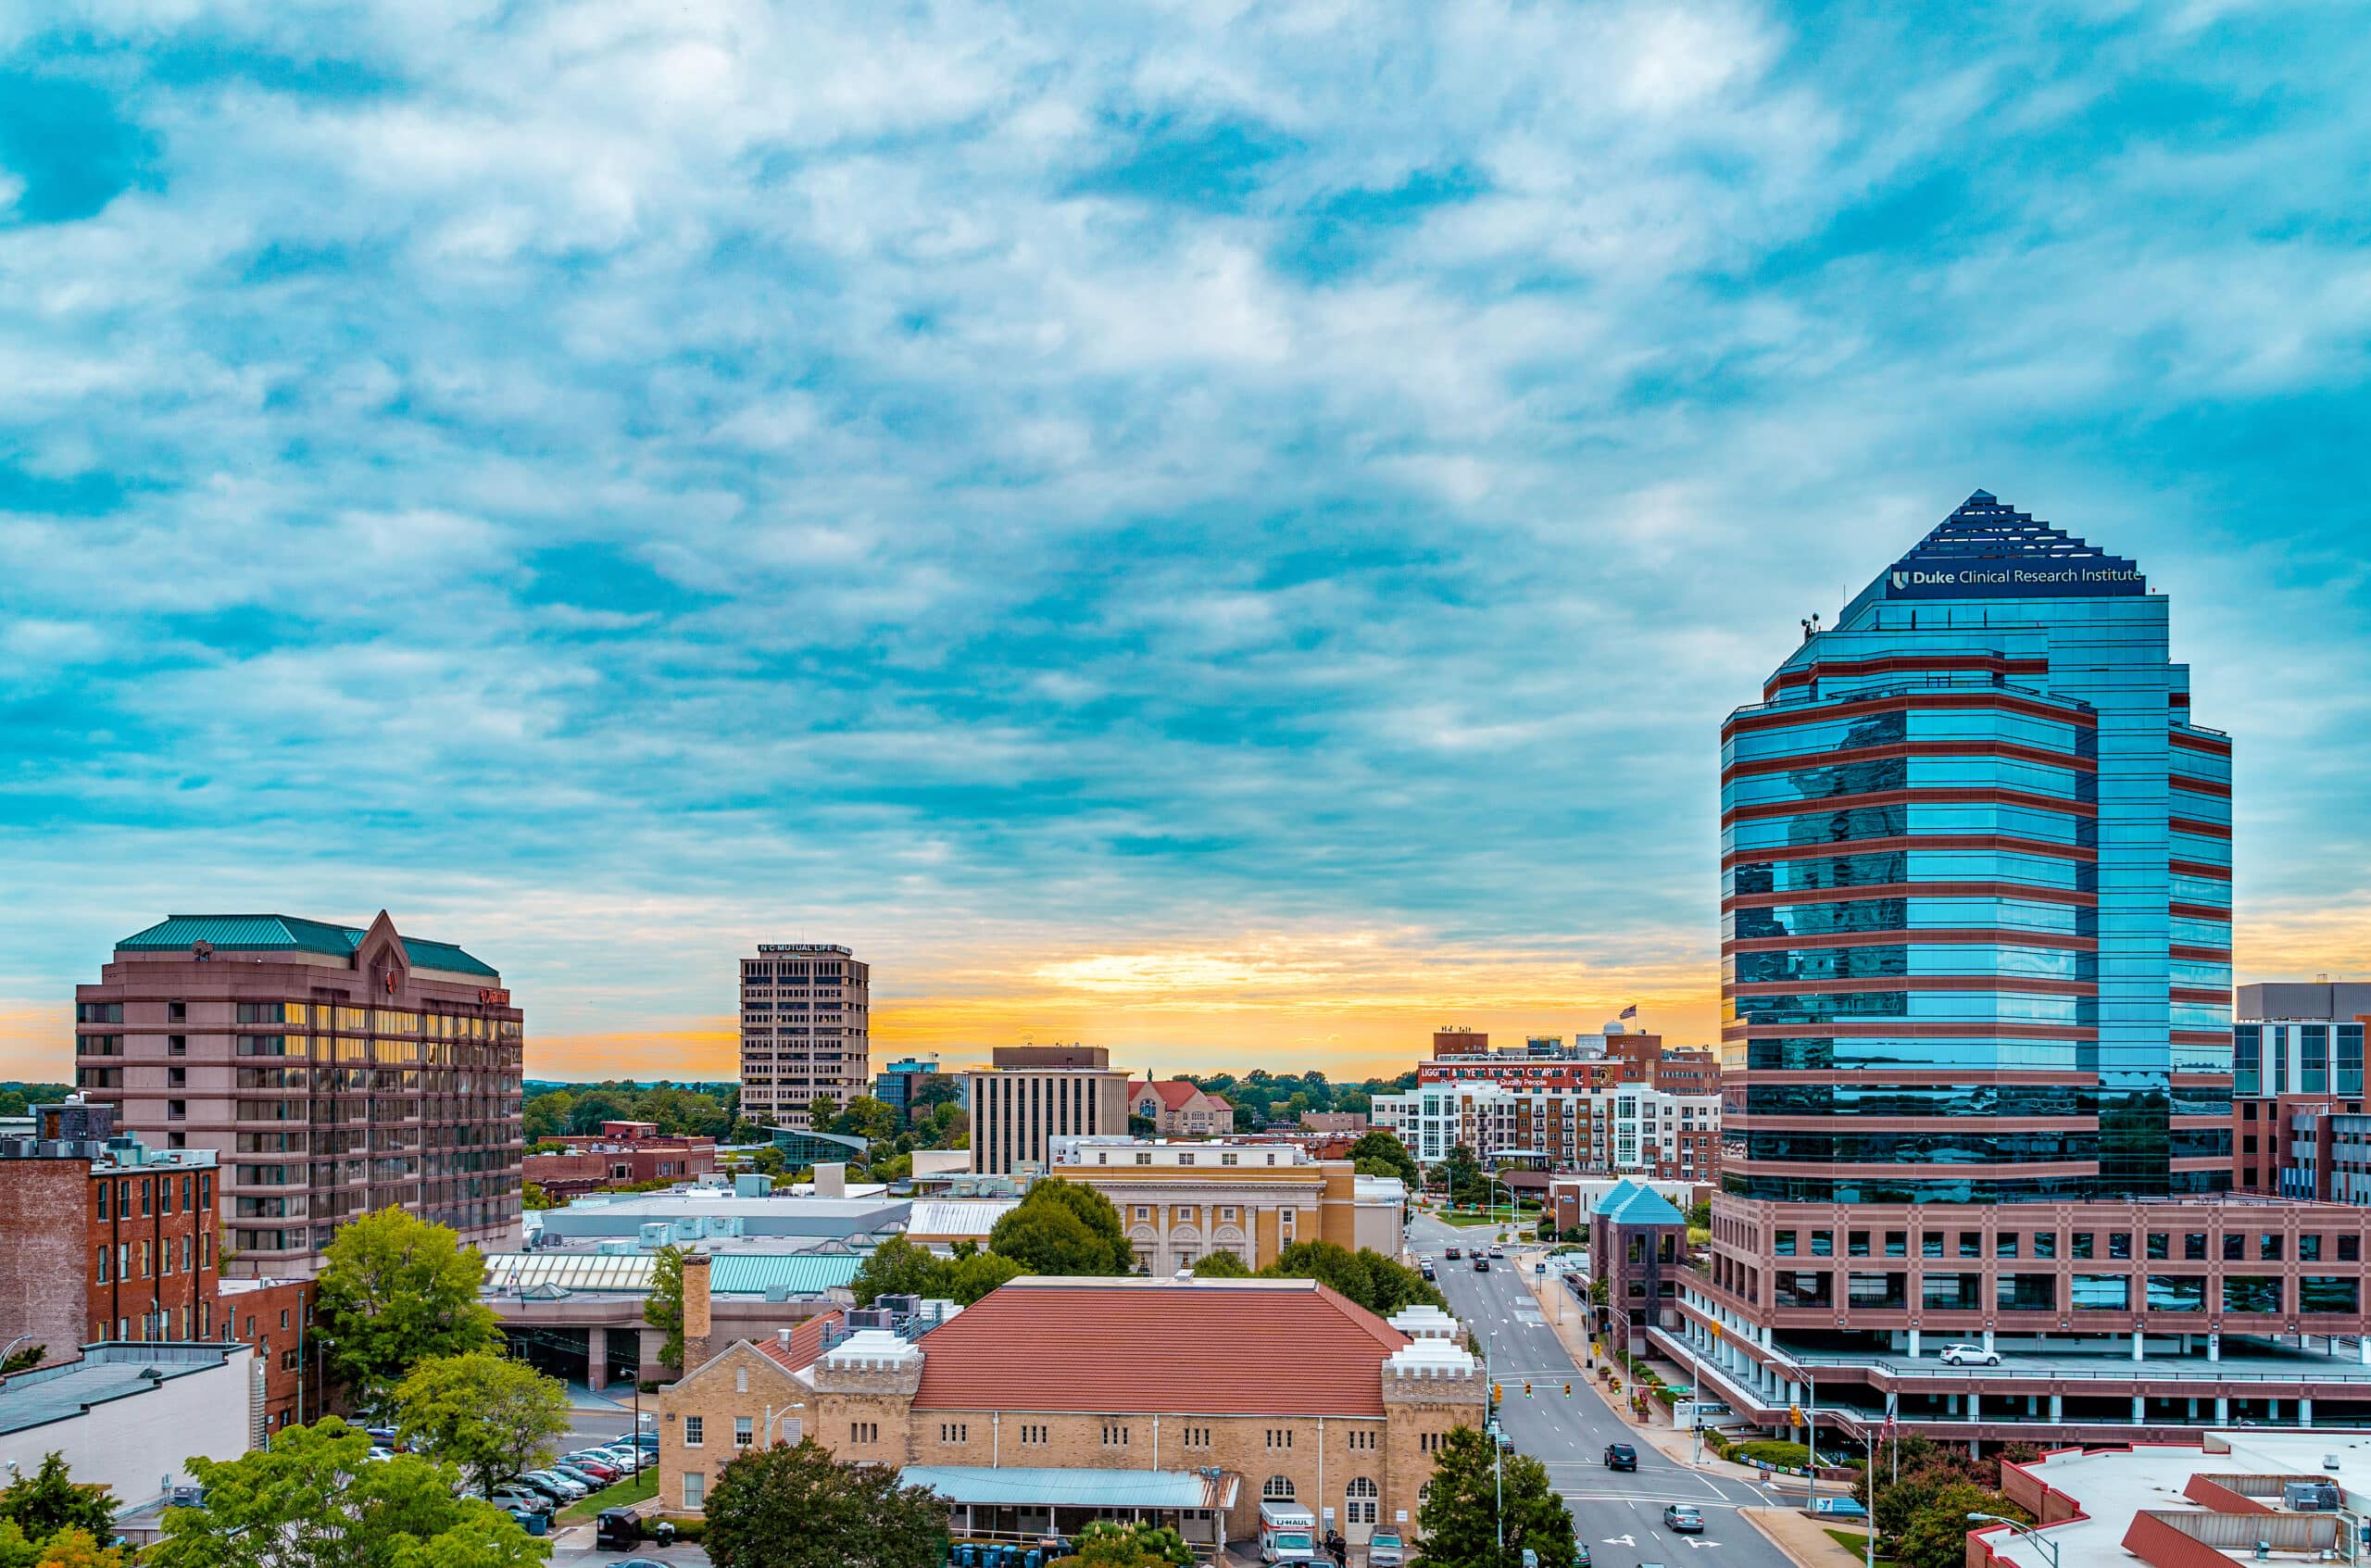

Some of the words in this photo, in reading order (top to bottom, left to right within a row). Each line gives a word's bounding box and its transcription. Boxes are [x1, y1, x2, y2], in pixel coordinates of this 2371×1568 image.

[1913, 571, 1955, 583] Duke
[1960, 570, 2009, 583] Clinical
[2014, 568, 2077, 583] Research
[2082, 568, 2141, 582] Institute
[1500, 1078, 1524, 1086] Quality
[1524, 1078, 1548, 1086] People
